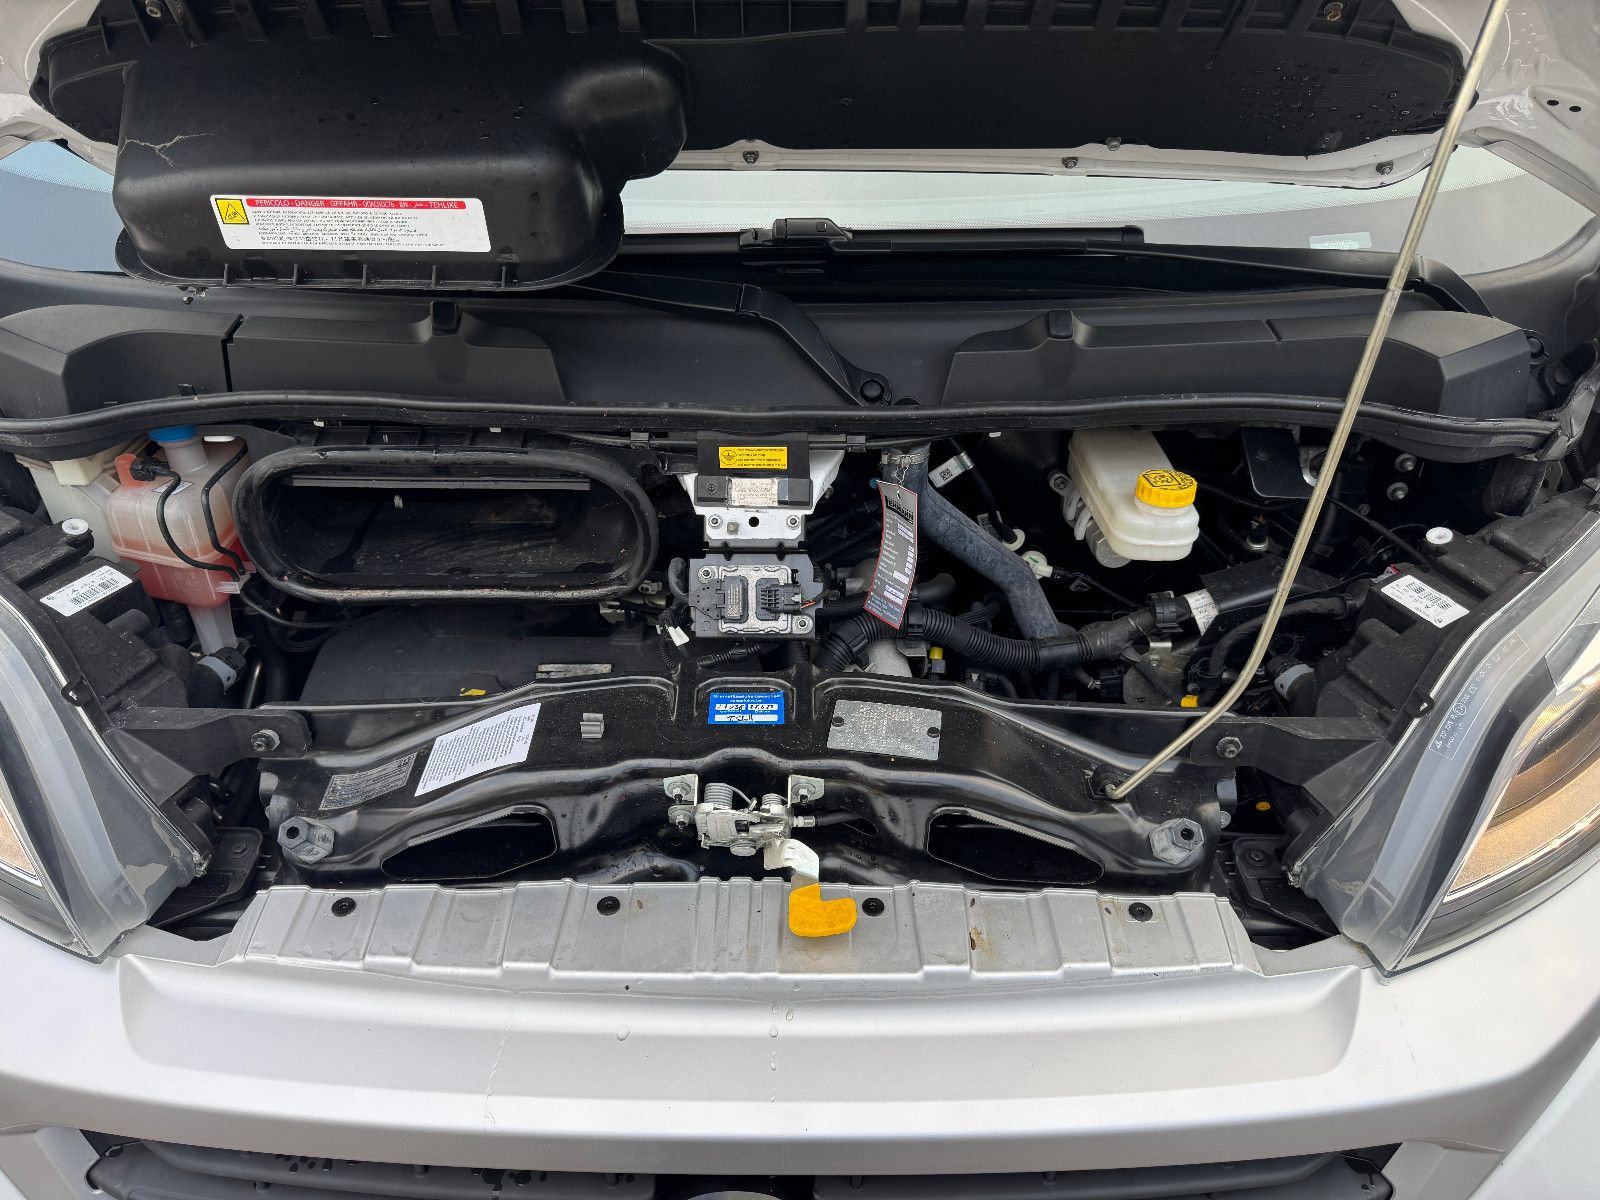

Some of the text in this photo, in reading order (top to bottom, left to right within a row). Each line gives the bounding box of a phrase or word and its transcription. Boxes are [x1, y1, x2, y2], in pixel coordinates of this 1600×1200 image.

[254, 199, 290, 207] PERICOLO
[295, 199, 326, 207] DANGER
[330, 200, 358, 208] GEFAHR
[428, 201, 458, 209] TEHLIKE
